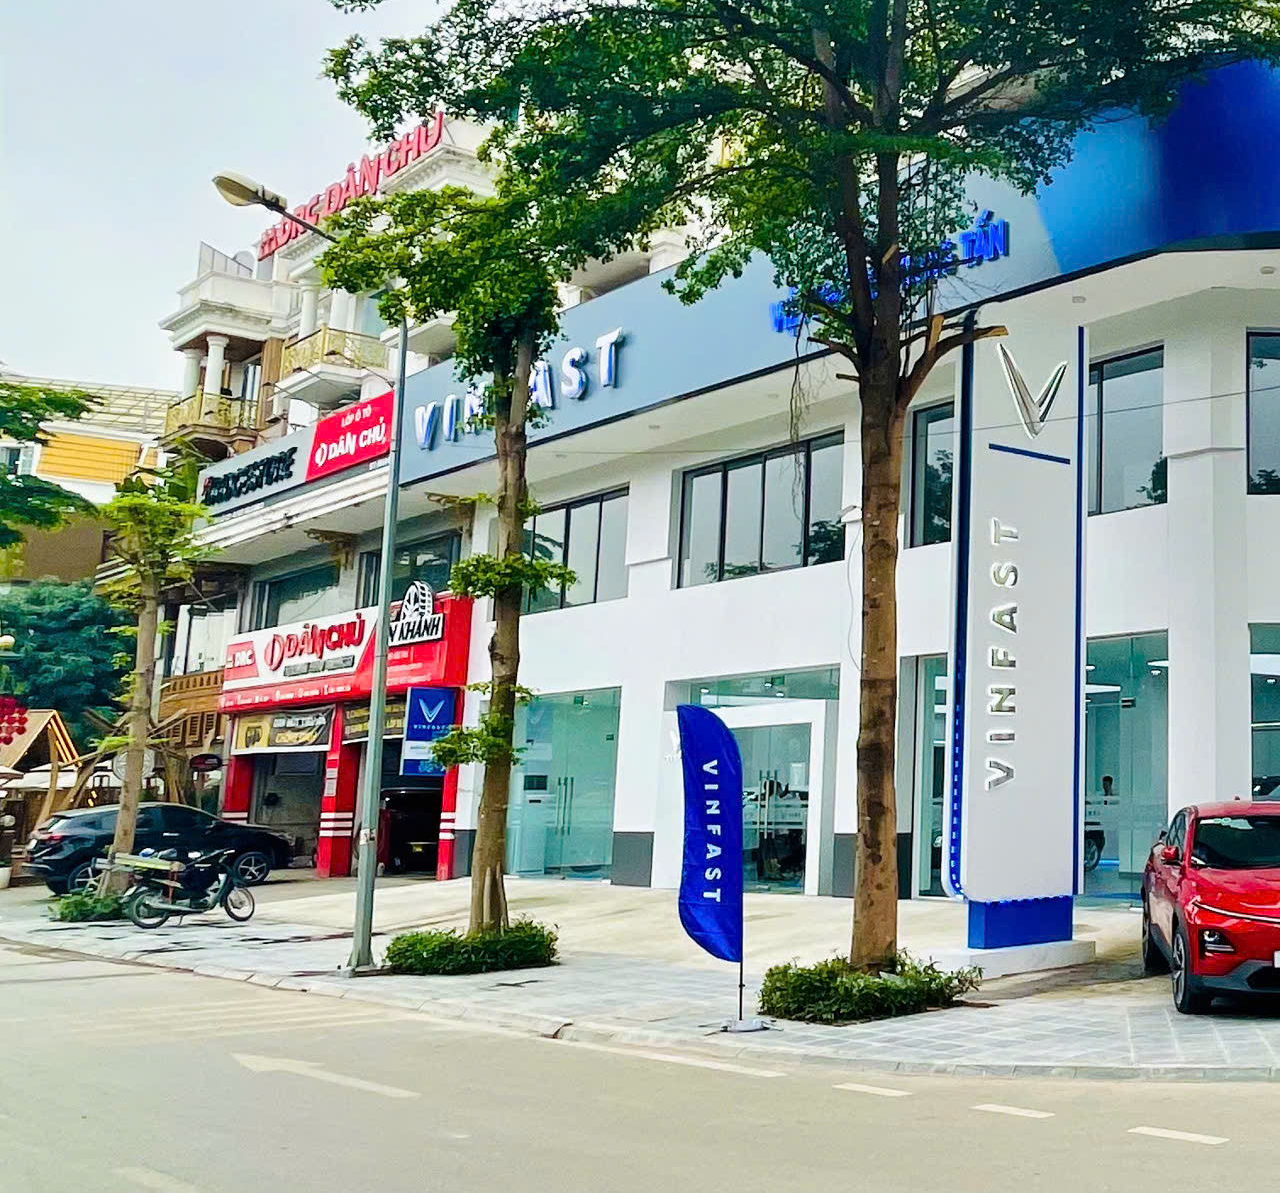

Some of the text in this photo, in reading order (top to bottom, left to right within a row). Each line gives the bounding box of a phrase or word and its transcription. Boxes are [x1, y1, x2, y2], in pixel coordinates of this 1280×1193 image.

[327, 416, 387, 460] DÂN CHỦ
[286, 623, 326, 659] DÂN
[985, 517, 1019, 791] VINFAST
[702, 759, 722, 903] VINFAST
